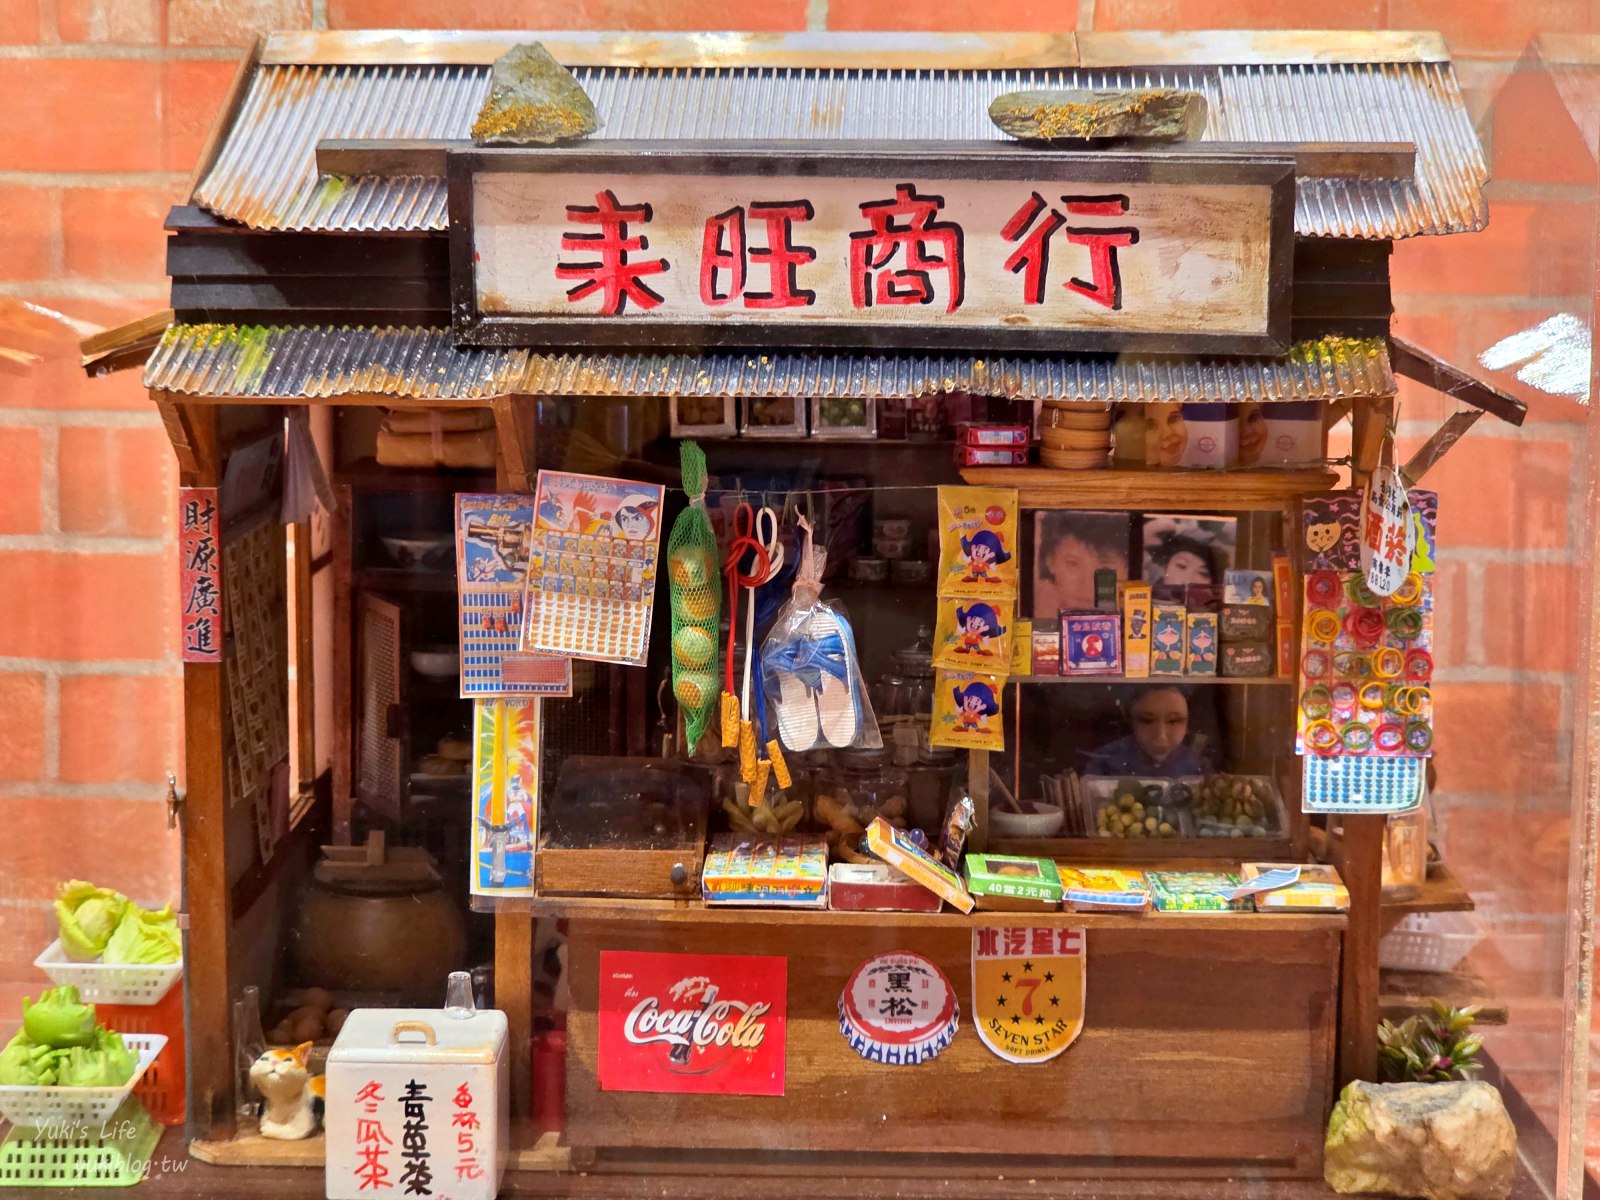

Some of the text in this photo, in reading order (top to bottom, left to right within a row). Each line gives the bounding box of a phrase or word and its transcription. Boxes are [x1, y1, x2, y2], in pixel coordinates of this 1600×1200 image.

[184, 498, 221, 655] 財源廣進
[879, 973, 918, 1017] 黑松
[1014, 978, 1041, 1016] 7
[624, 997, 772, 1048] Coca-Cola
[989, 1018, 1069, 1046] SEVEN STAR
[354, 1079, 394, 1192] 冬瓜茶
[398, 1078, 433, 1196] 青草茶
